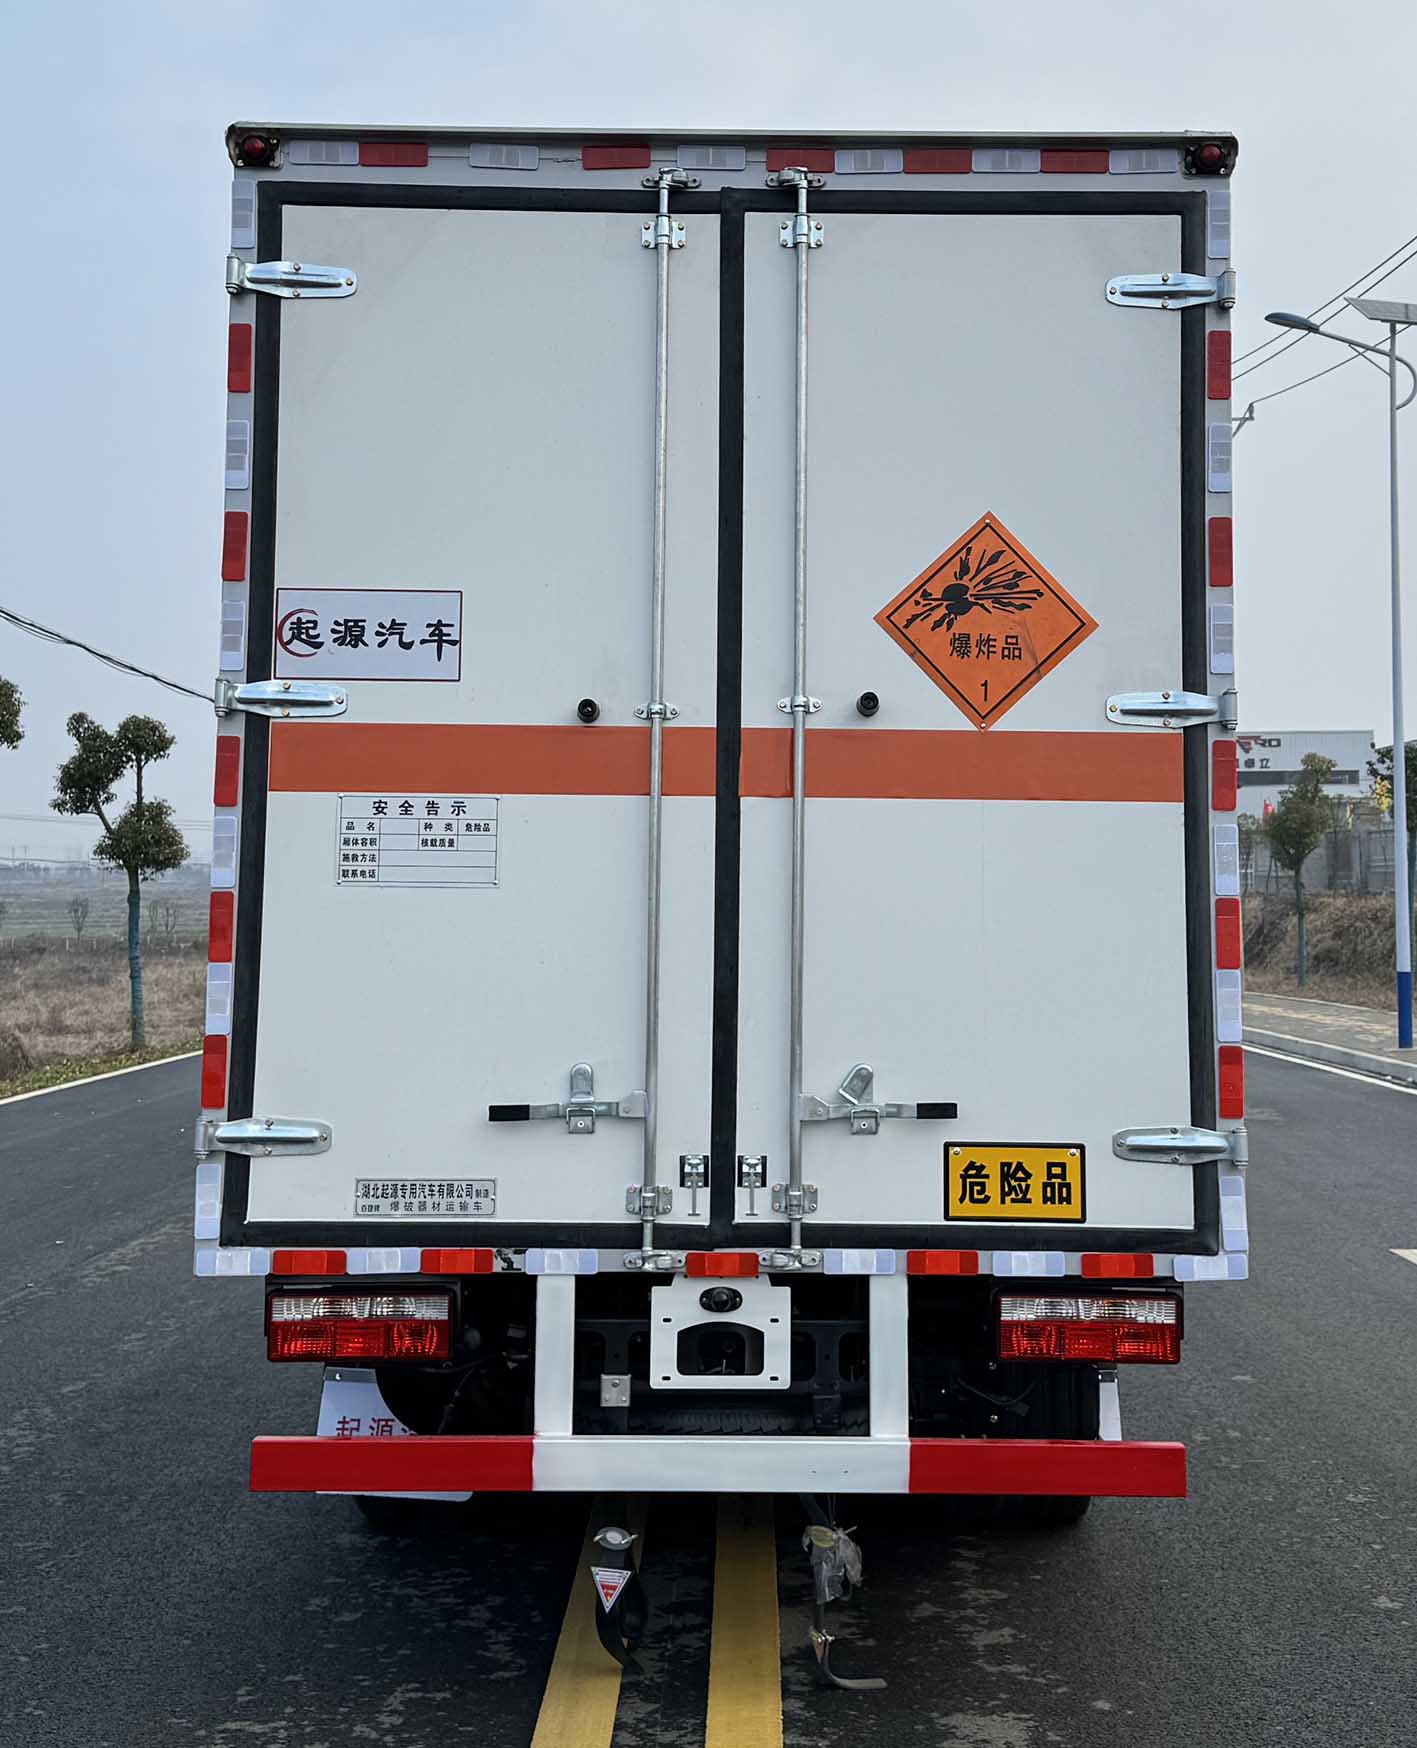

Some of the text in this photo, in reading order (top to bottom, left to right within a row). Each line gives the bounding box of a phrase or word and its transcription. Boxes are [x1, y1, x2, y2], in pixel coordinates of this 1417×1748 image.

[287, 616, 460, 662] 起源汽车
[949, 632, 1023, 661] 爆炸品
[979, 679, 989, 702] 1
[372, 799, 467, 816] 安全告示
[465, 822, 491, 833] 危险品
[341, 868, 377, 879] 联系电话
[958, 1160, 1073, 1206] 危险品
